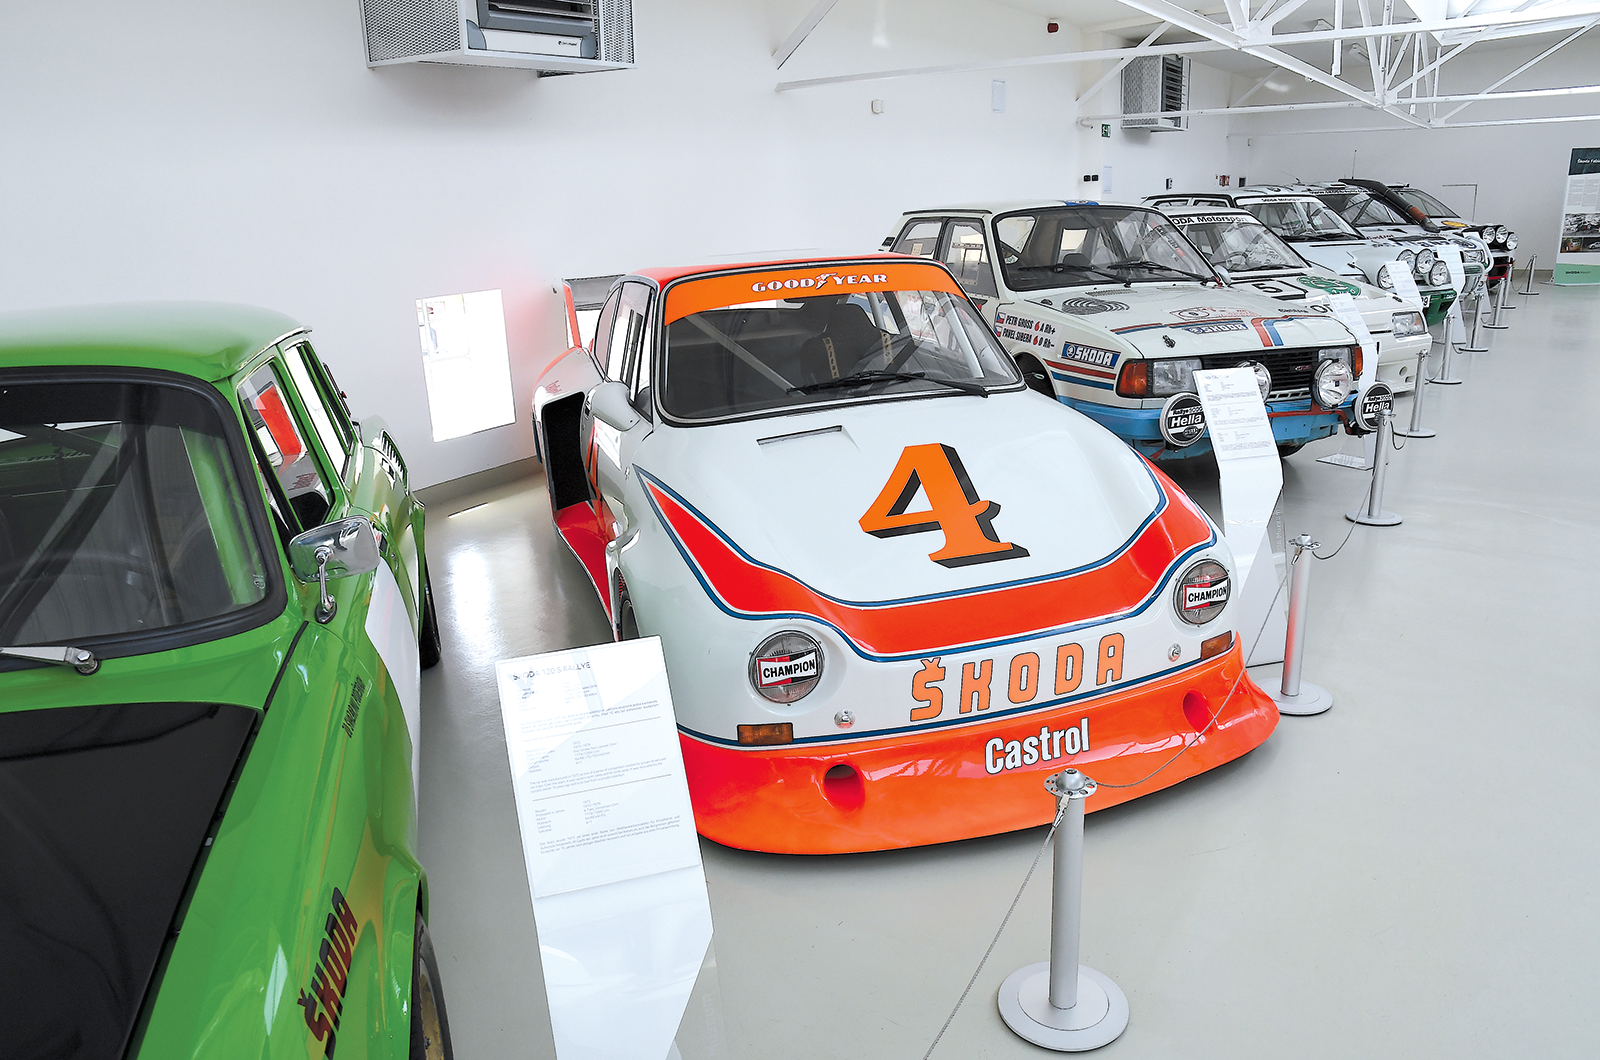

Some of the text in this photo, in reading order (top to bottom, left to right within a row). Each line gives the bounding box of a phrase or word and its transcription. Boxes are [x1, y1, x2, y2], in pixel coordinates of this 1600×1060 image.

[1172, 217, 1194, 225] ODA
[832, 274, 888, 285] YEAR
[1005, 315, 1018, 326] PETR
[1018, 318, 1034, 330] GROSS
[1002, 328, 1015, 340] PAVEL
[1365, 402, 1390, 413] Hella
[1171, 414, 1202, 427] Hella
[858, 442, 1029, 568] 4
[1188, 586, 1227, 602] CHAMPION
[763, 659, 815, 678] CHAMPION
[910, 632, 1124, 722] ŠKODA
[985, 717, 1090, 775] Castrol
[297, 887, 358, 1060] ŠKODA
